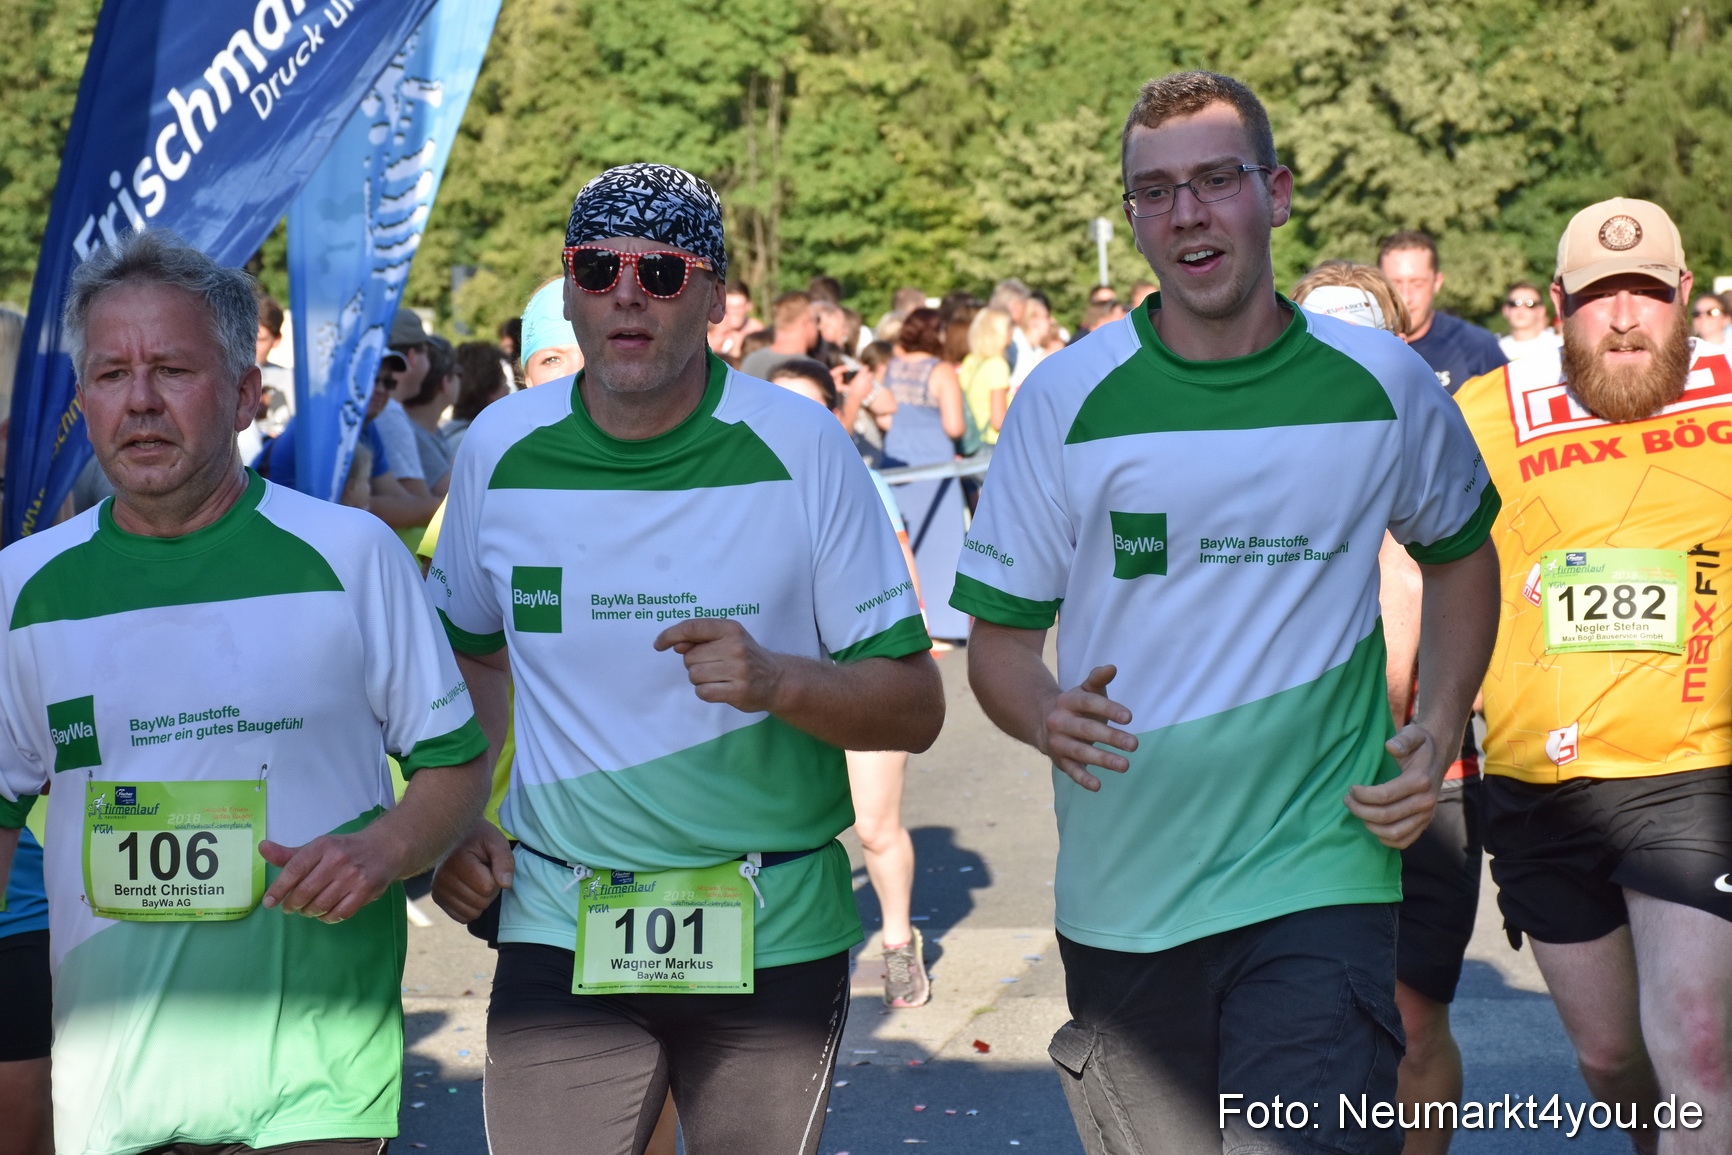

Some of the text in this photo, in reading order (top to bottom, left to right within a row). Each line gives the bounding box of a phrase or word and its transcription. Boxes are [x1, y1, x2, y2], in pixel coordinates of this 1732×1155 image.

[250, 24, 325, 121] Druck
[73, 0, 306, 262] Frischma
[1519, 437, 1628, 483] MAX
[1115, 534, 1164, 555] BayWa
[1200, 535, 1309, 551] BayWa Baustoffe
[1200, 552, 1242, 564] Immer
[1244, 551, 1264, 563] ein
[1267, 552, 1301, 566] gutes
[1557, 564, 1606, 575] firmenlauf
[513, 589, 559, 608] BayWa
[591, 592, 698, 608] BayWa Baustoffe
[1558, 584, 1666, 622] 1282
[591, 603, 760, 622] Immer ein gutes Baugefühl
[1575, 622, 1650, 633] Negler Stefan
[1578, 633, 1595, 642] Bögl
[130, 705, 240, 733] BayWa Baustoffe
[50, 722, 94, 746] BayWa
[131, 718, 304, 747] Immer ein gutes Baugefühl
[104, 803, 160, 815] firmenlauf
[167, 813, 201, 825] 2018
[118, 831, 219, 881] 106
[114, 884, 224, 896] Berndt Christian
[600, 881, 657, 895] firmenlauf
[663, 891, 695, 901] 2018
[142, 899, 191, 909] BayWa AG
[615, 907, 704, 955] 101
[611, 958, 713, 971] Wagner Markus
[637, 972, 685, 981] BayWa AG
